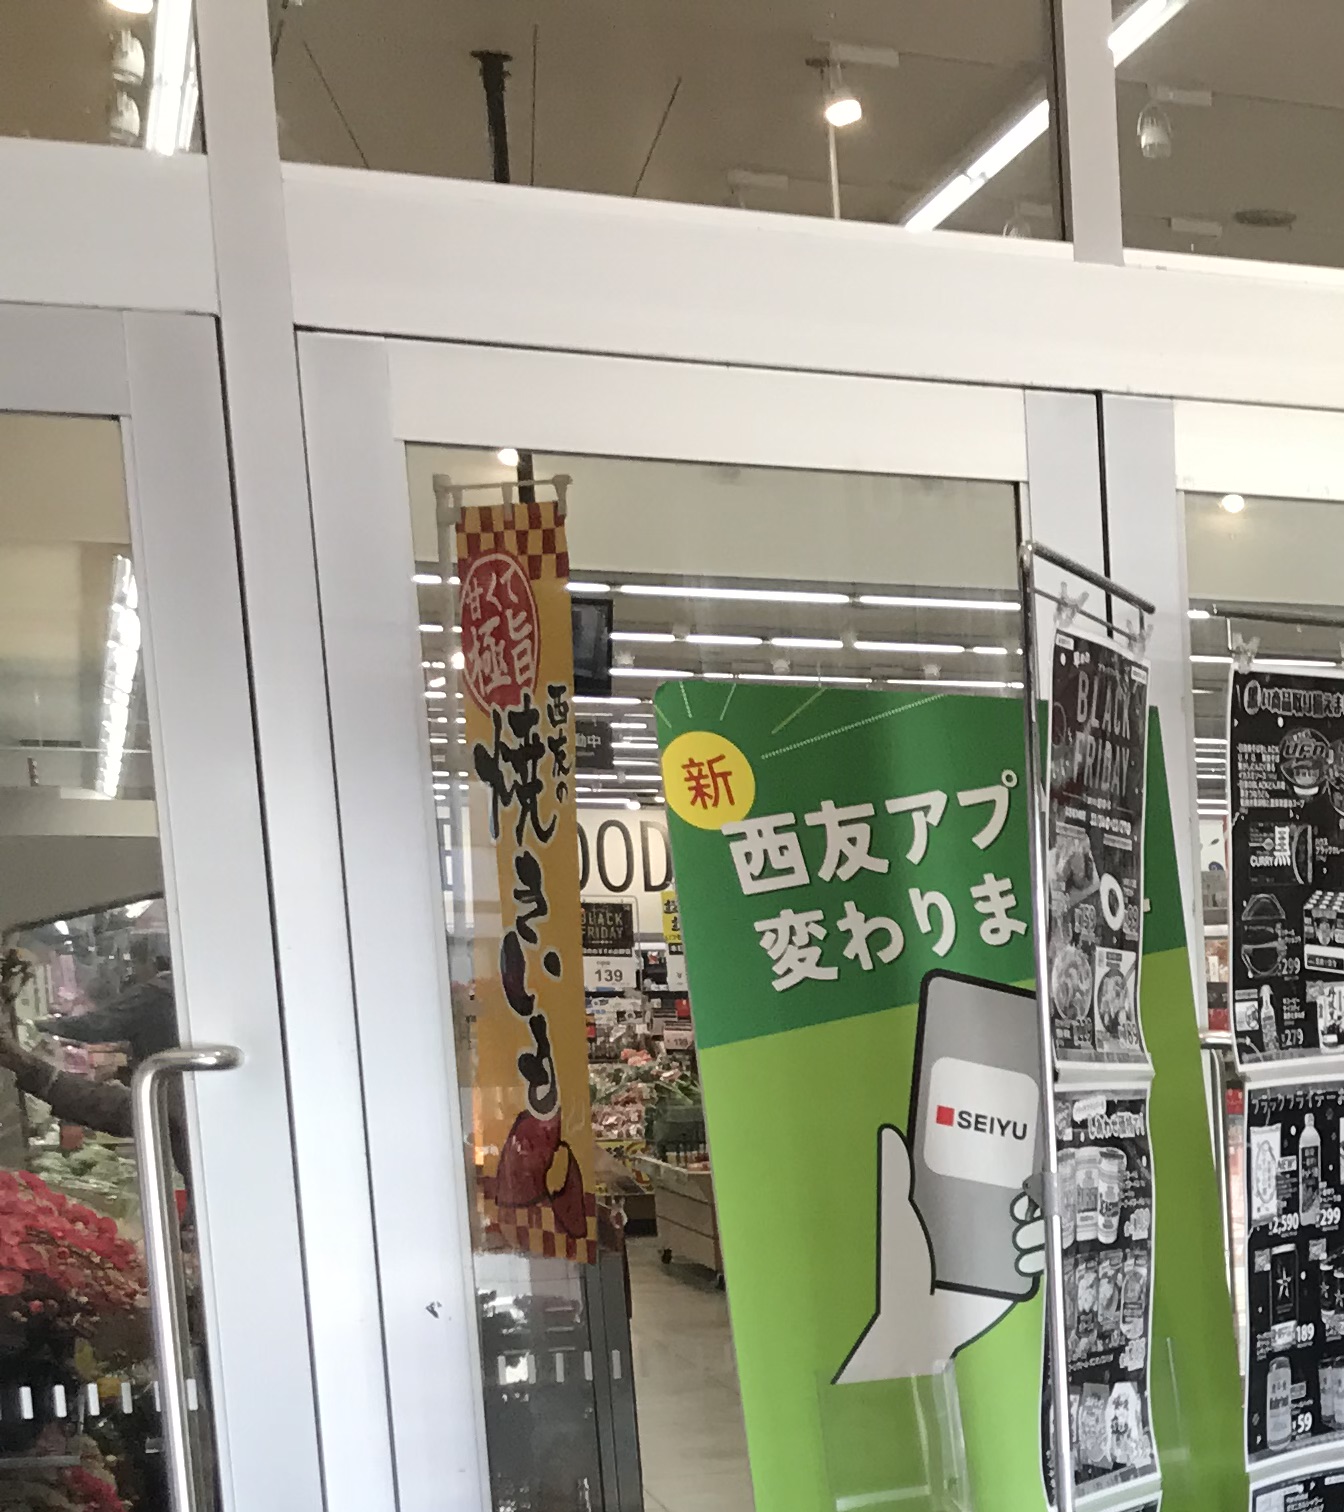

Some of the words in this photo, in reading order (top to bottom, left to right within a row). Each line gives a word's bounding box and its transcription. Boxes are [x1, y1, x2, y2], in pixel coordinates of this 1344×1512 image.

[1076, 670, 1131, 740] BLACK
[682, 754, 735, 810] 新
[1073, 730, 1130, 796] FRIDAY
[722, 770, 1020, 896] 西友アプ
[755, 874, 1028, 993] 変わりま
[594, 968, 624, 983] 139
[955, 1110, 1028, 1143] SEIYU
[1272, 1212, 1299, 1234] 2,590
[1319, 1206, 1341, 1226] 299
[1297, 1411, 1313, 1433] 59
